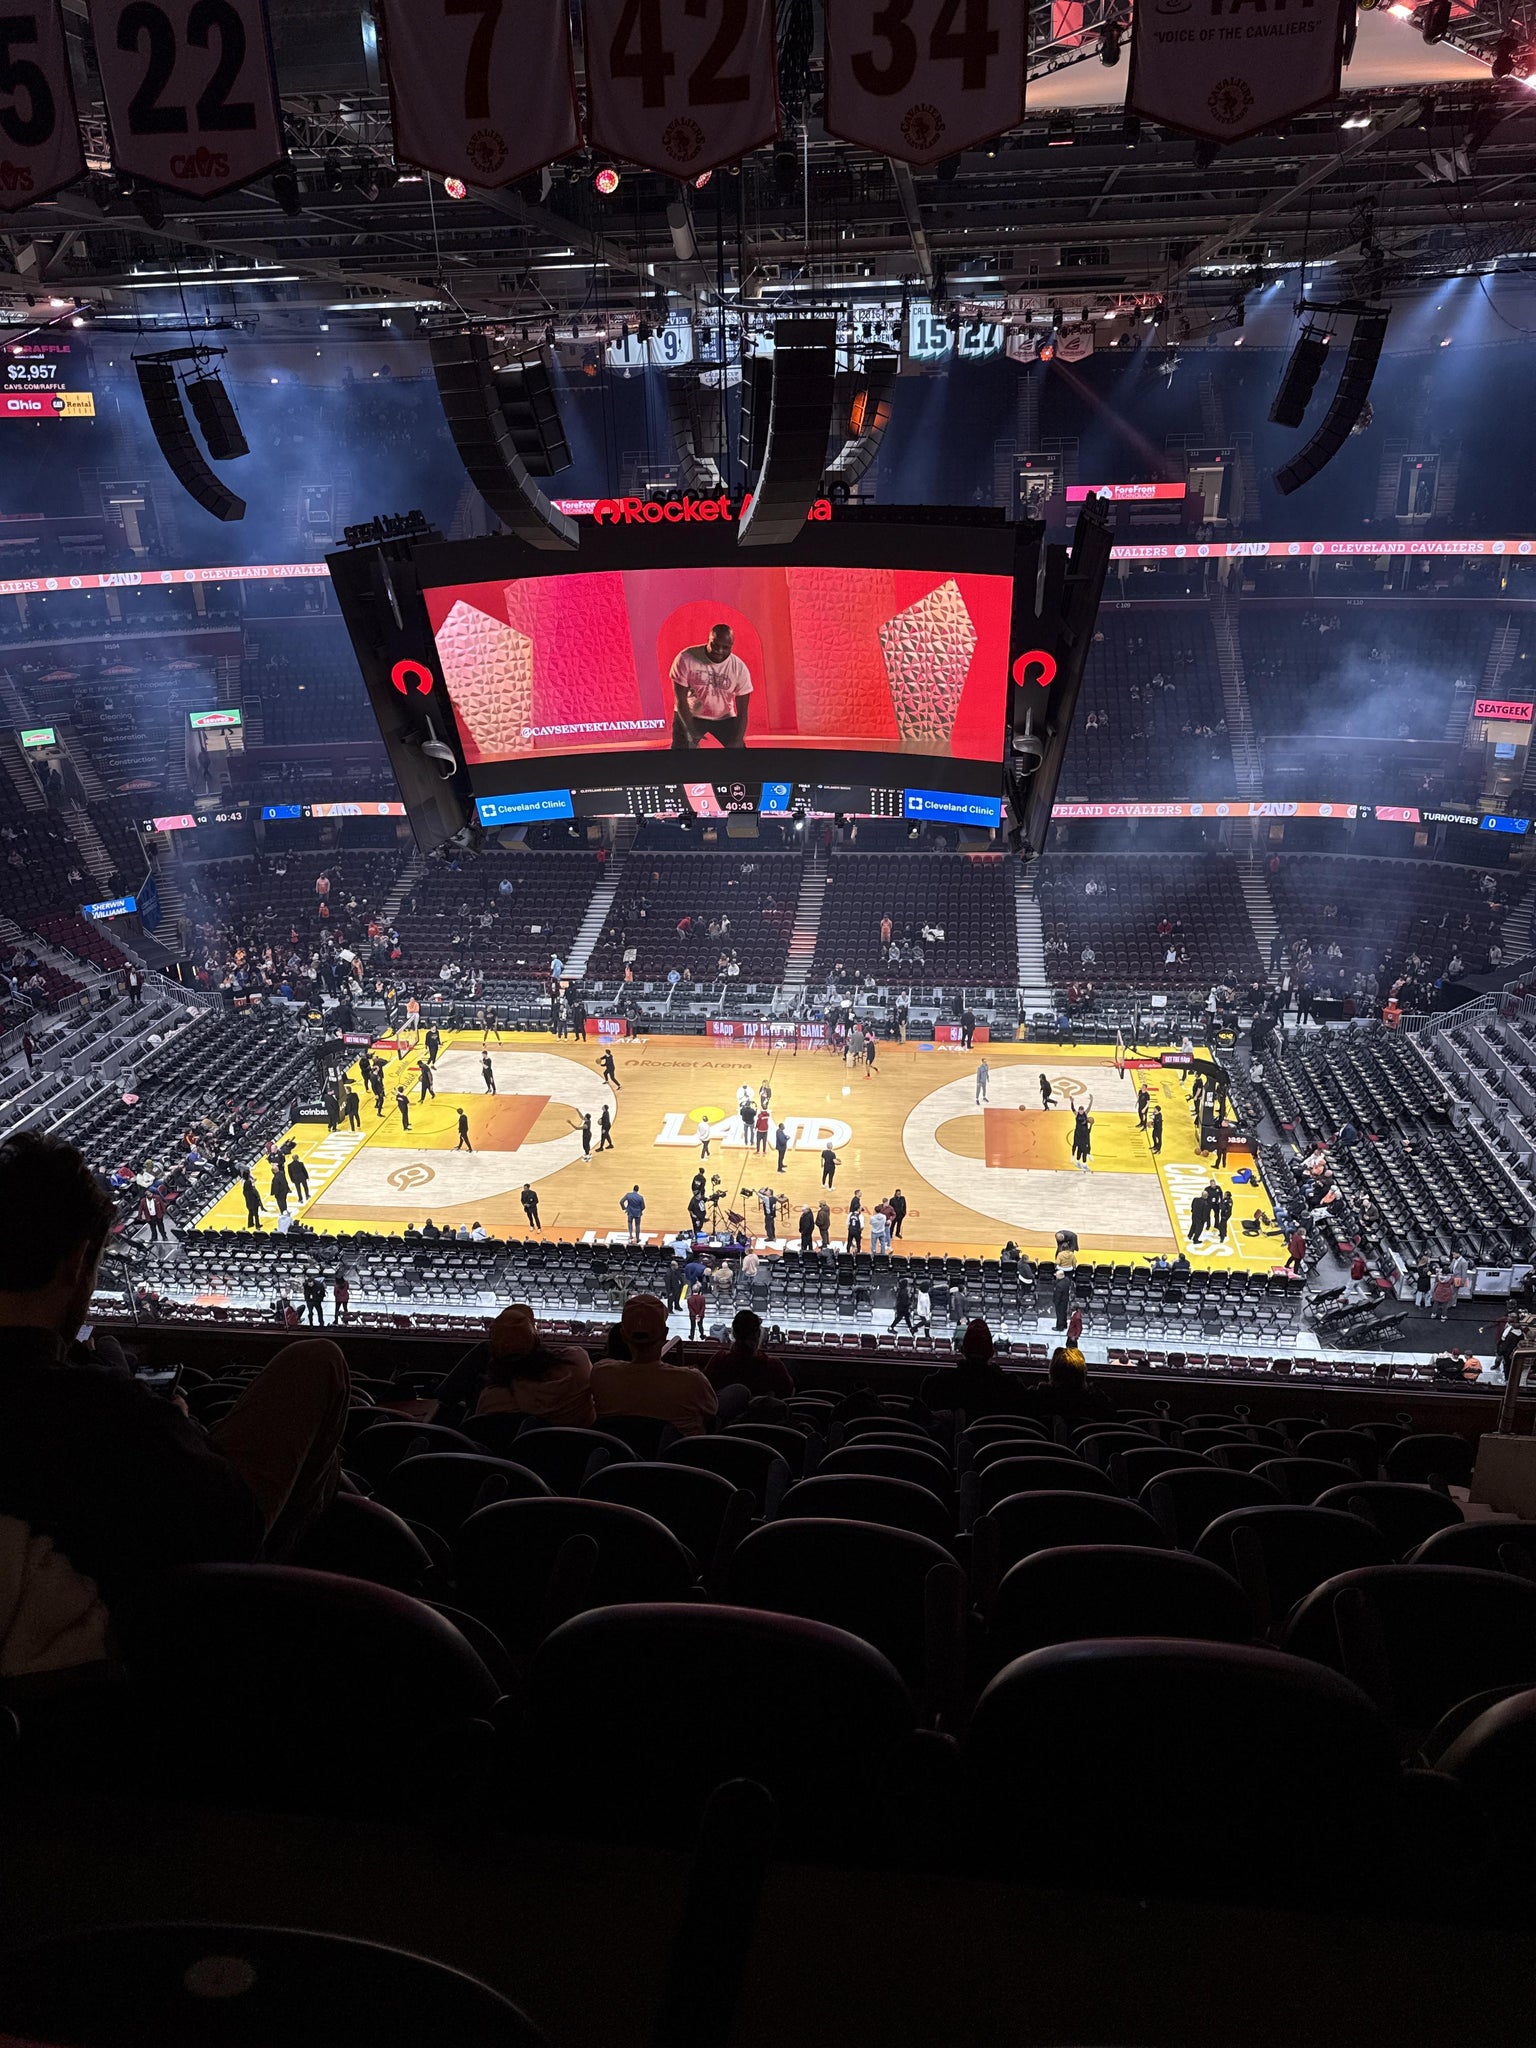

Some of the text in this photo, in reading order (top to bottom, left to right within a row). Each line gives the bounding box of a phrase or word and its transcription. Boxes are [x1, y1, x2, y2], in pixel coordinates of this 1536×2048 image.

[1198, 27, 1215, 42] OF
[1218, 25, 1241, 41] THE
[609, 0, 750, 108] 42
[850, 0, 999, 96] 34
[444, 0, 500, 118] 7
[117, 0, 256, 135] 22
[0, 14, 56, 147] 5
[170, 147, 230, 179] CAVS
[0, 163, 34, 191] VS
[917, 319, 947, 349] 15
[663, 331, 679, 361] 9
[7, 365, 57, 381] $2,957
[1115, 486, 1156, 494] ForeFront
[561, 500, 597, 509] ForeFro
[624, 494, 732, 524] Rocket
[1110, 546, 1168, 557] AVALIERS
[1225, 542, 1270, 556] LAND
[1331, 542, 1484, 553] CLEVELAND CAVALIERS
[98, 572, 142, 586] LAND
[202, 565, 331, 580] CLEVELAND CAVALIER
[1, 581, 39, 592] LIERS
[1477, 703, 1530, 717] SEATGEEK
[100, 712, 132, 723] Cleaning
[521, 719, 665, 738] @CAVSENTERTAINMENT
[103, 733, 146, 743] Restoration
[109, 756, 156, 767] Construction
[498, 800, 566, 814] Cleveland Clinic
[701, 800, 708, 809] 0
[726, 802, 753, 811] 40:43
[770, 800, 777, 809] 0
[924, 801, 994, 816] Cleveland Clinic
[1052, 805, 1183, 816] VELAND CAVALIERS
[1248, 802, 1298, 817] LAND
[215, 812, 242, 822] 40:43
[269, 809, 277, 818] 0
[1403, 810, 1411, 820] 0
[1423, 812, 1479, 825] TURNOVERS
[181, 817, 188, 827] 0
[1488, 818, 1497, 828] 0
[91, 900, 125, 912] SHERWIN
[605, 1021, 620, 1035] App
[720, 1022, 734, 1036] App
[742, 1023, 758, 1036] TAP
[800, 1024, 825, 1038] GAME
[640, 1060, 753, 1070] Rocket Arena
[299, 1108, 329, 1116] coinba
[653, 1111, 853, 1151] LAND
[1206, 1135, 1247, 1144] coase
[257, 1130, 367, 1218] LELAND
[1163, 1163, 1235, 1257] CAVALRS
